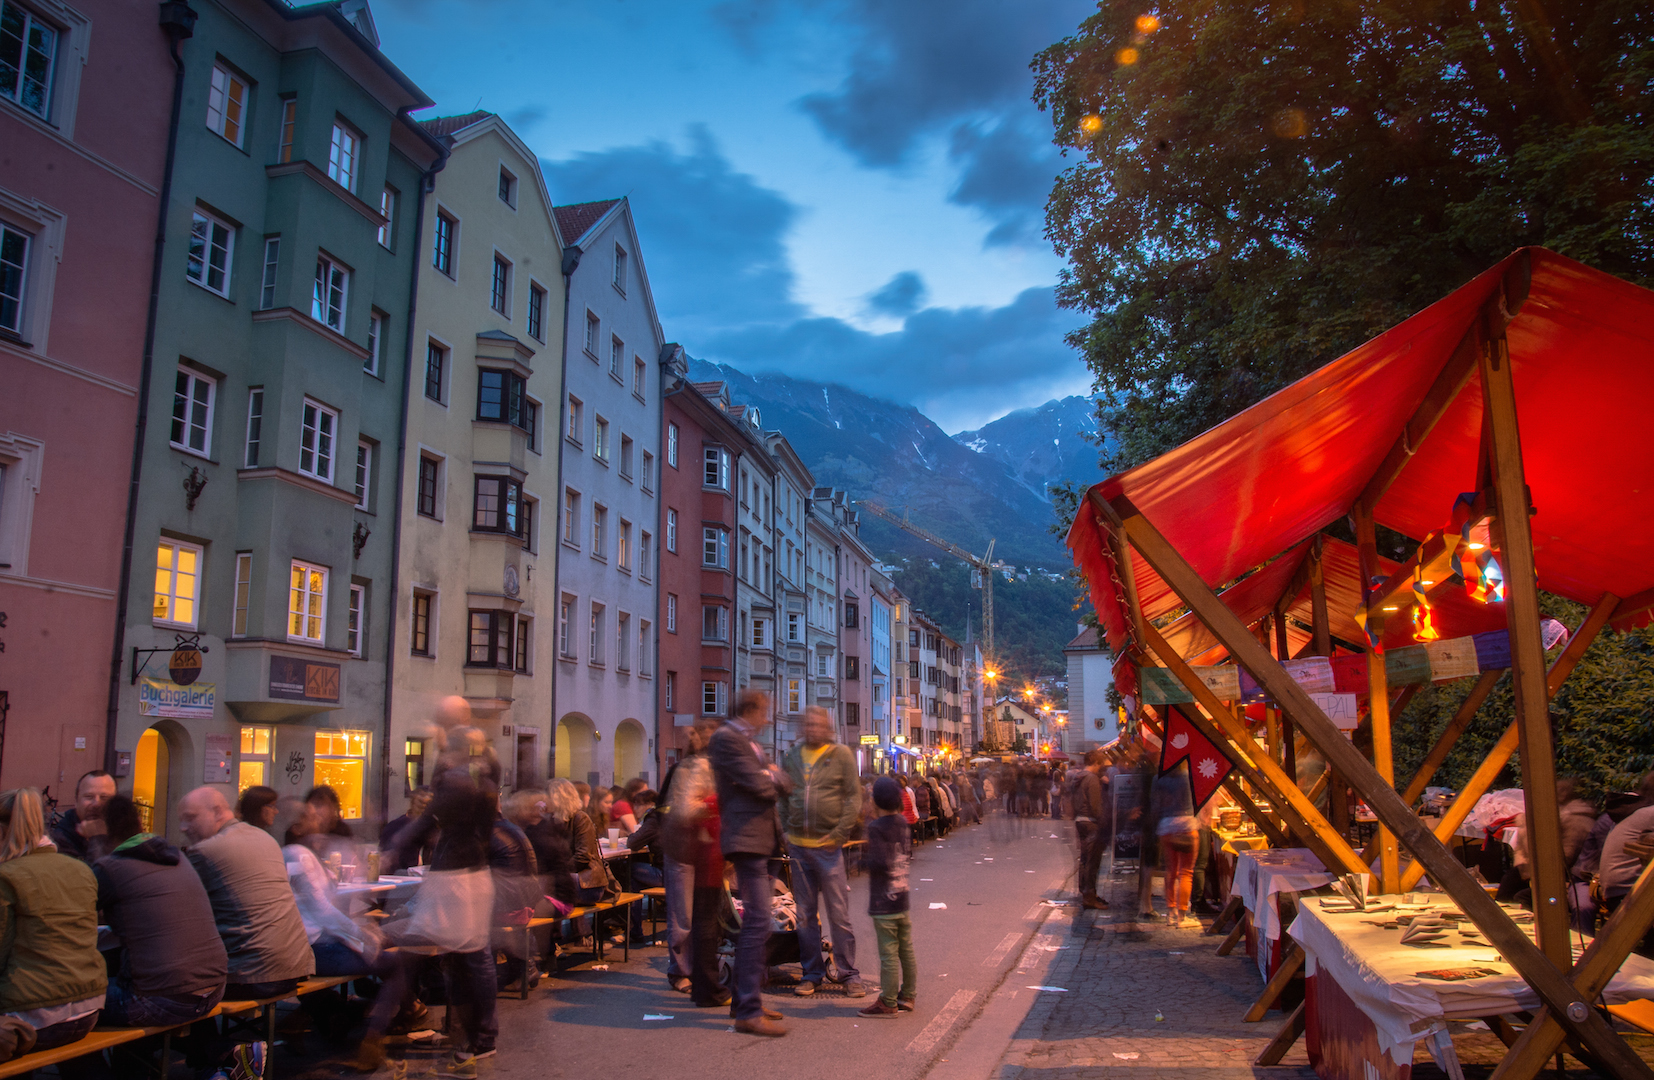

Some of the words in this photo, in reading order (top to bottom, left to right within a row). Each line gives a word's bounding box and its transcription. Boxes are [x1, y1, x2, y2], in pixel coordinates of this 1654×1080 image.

[174, 651, 198, 664] KIK
[307, 666, 338, 689] KIK
[141, 683, 215, 707] Buchgalerie
